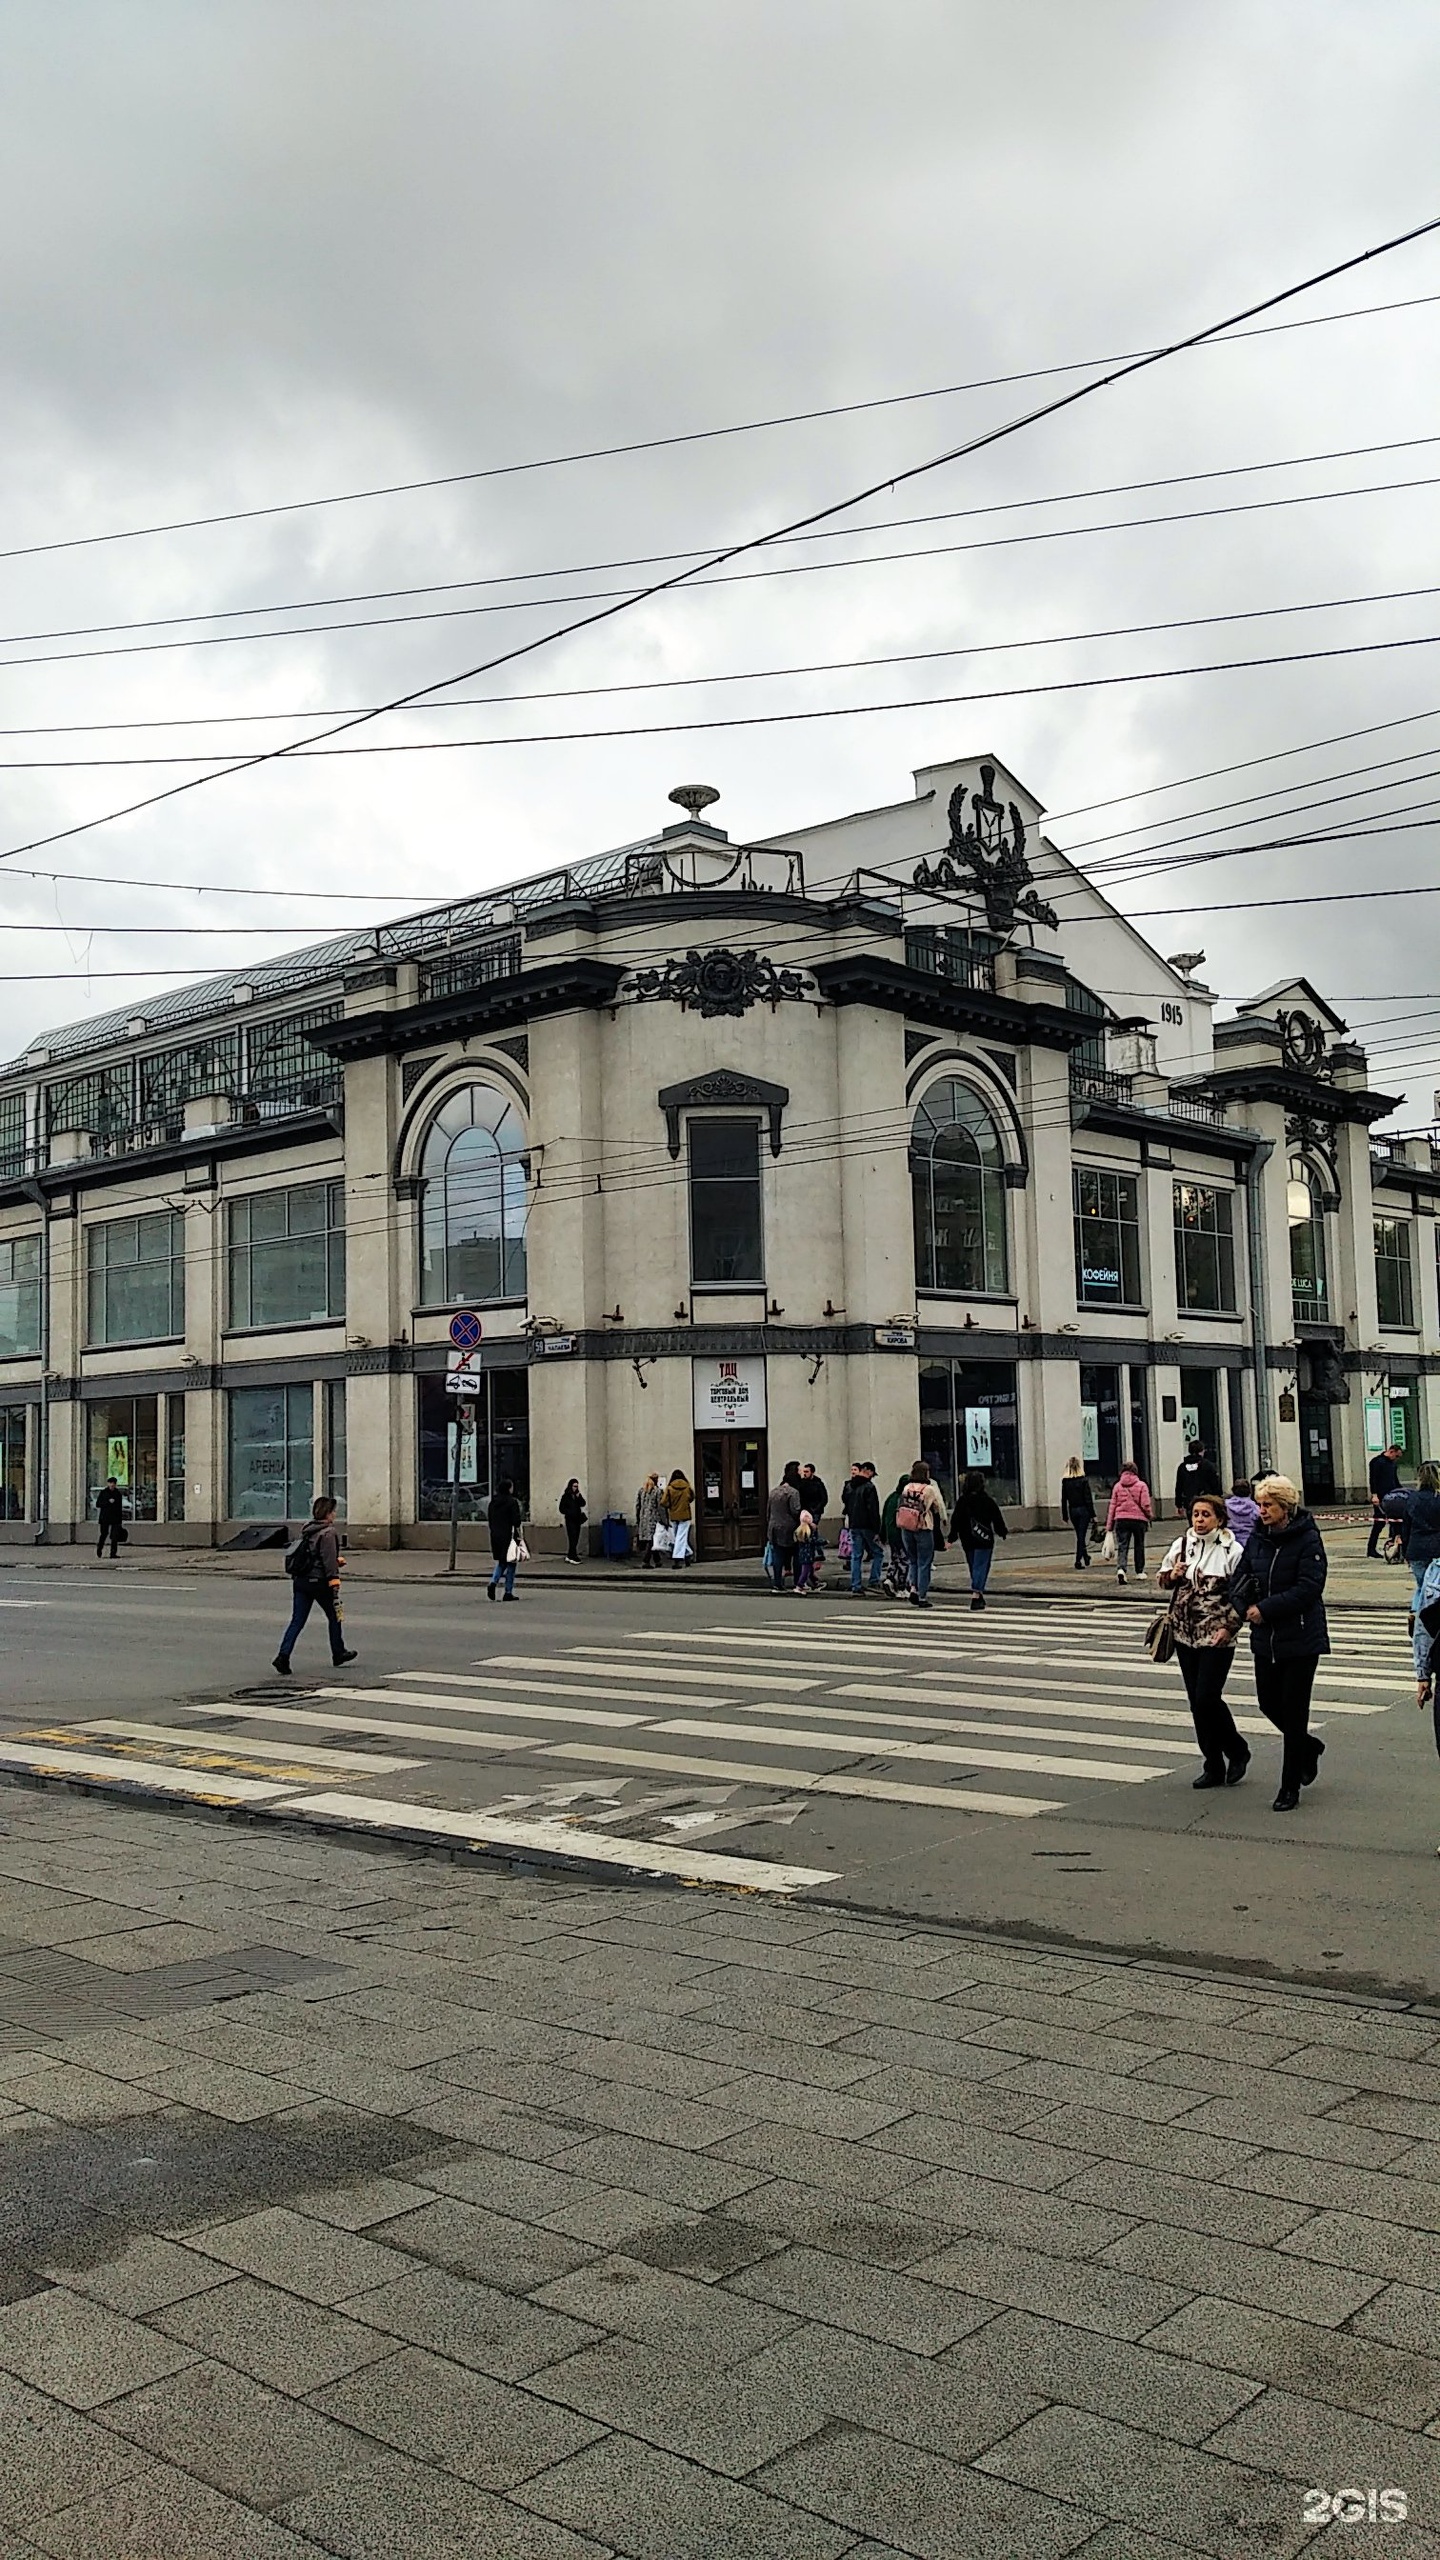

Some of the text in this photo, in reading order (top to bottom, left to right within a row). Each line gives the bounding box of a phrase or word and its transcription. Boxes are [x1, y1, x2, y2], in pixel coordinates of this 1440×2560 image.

[1160, 1001, 1183, 1026] 1915
[1082, 1267, 1119, 1282] КОФЕЙНЯ
[1297, 1278, 1313, 1288] LUCA
[719, 1362, 738, 1379] ТДЦ
[710, 1387, 736, 1395] ТОРГОВЫЙ
[710, 1394, 749, 1403] ЦЕНТРАЛЬНЫЙ
